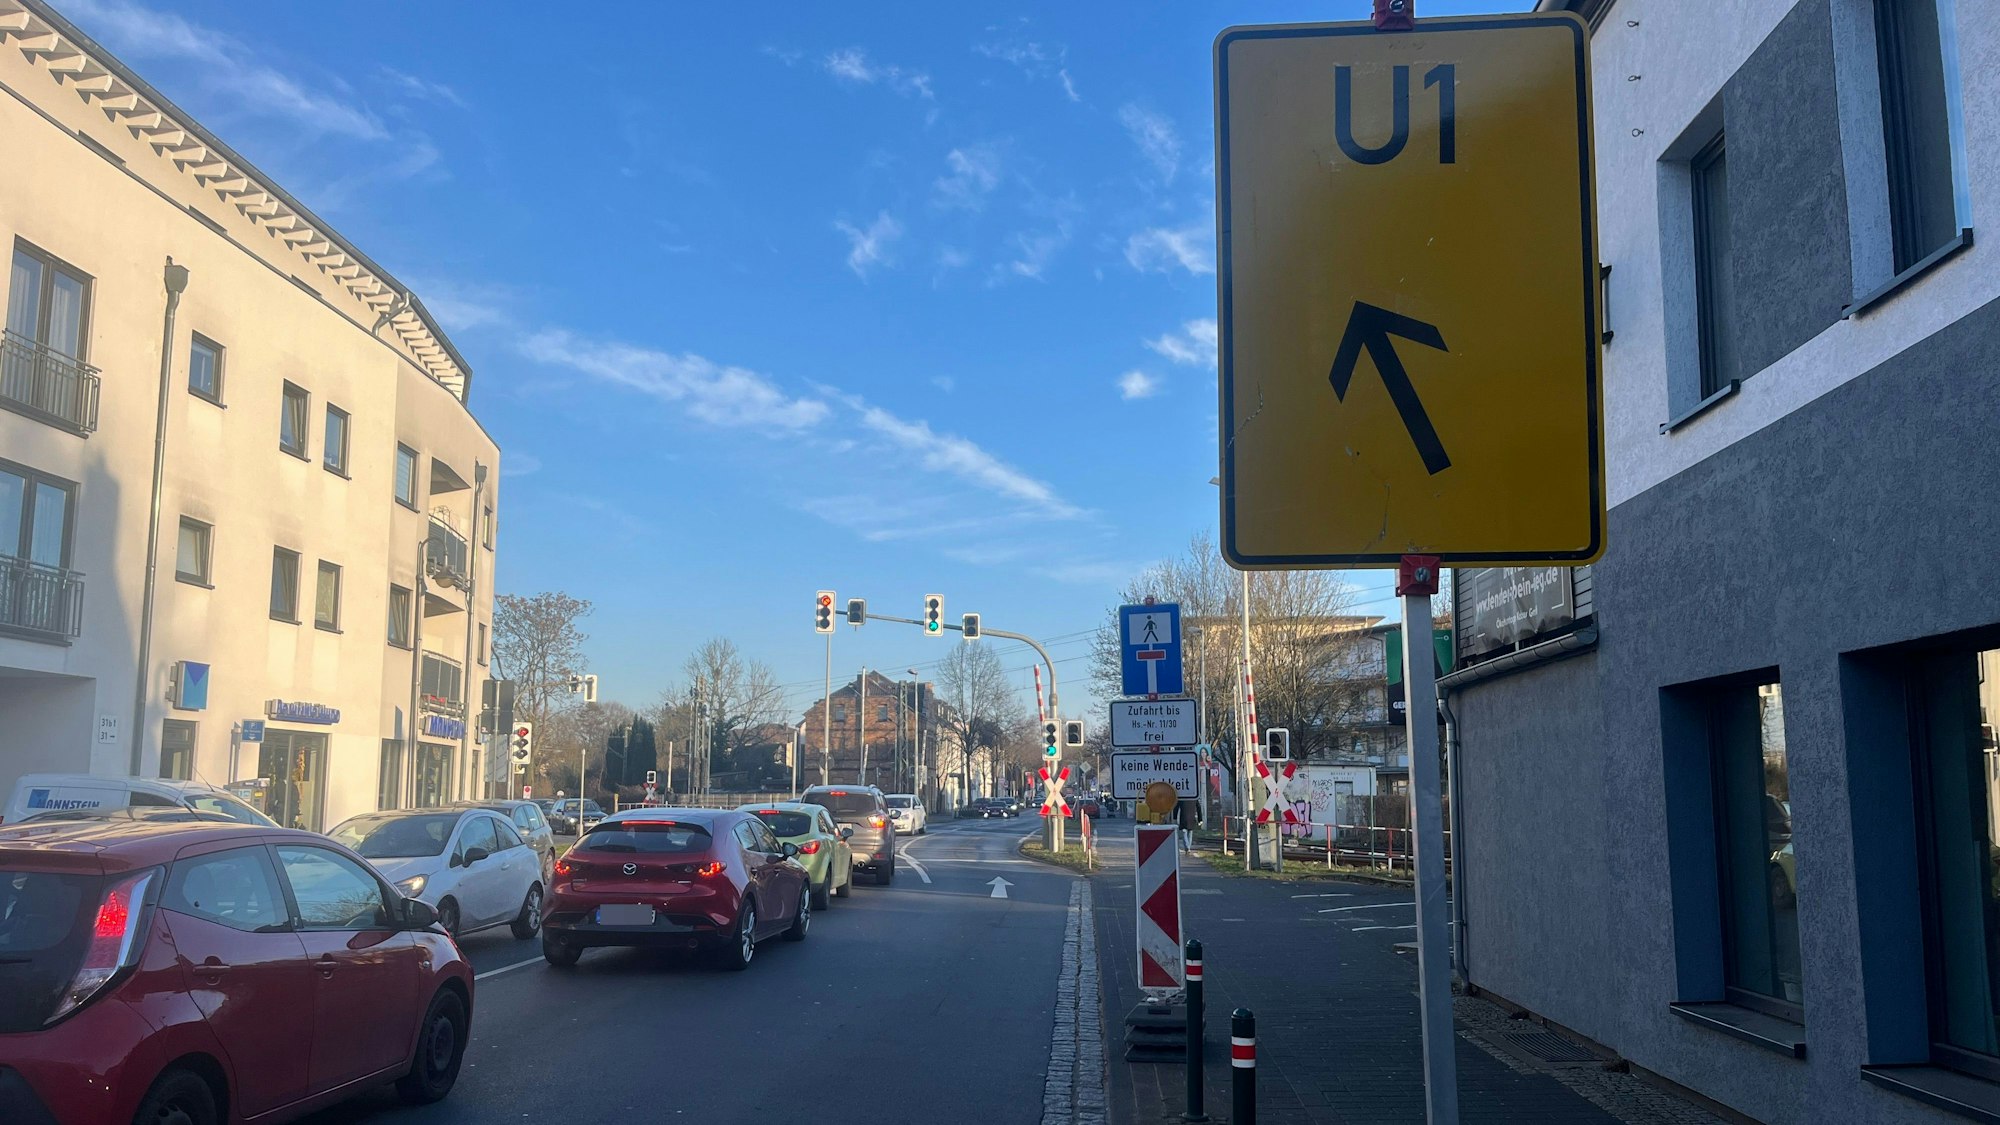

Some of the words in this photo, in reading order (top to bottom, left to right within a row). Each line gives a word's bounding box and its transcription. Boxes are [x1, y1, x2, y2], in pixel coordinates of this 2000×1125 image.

[1334, 63, 1456, 165] U1
[1128, 705, 1163, 716] Zufahrt
[1166, 705, 1180, 716] bis
[1132, 720, 1158, 729] Hs.-Nr.
[1159, 719, 1177, 728] 11/30
[1144, 731, 1164, 742] frei
[1121, 759, 1149, 771] keine
[1153, 759, 1194, 771] Wende-
